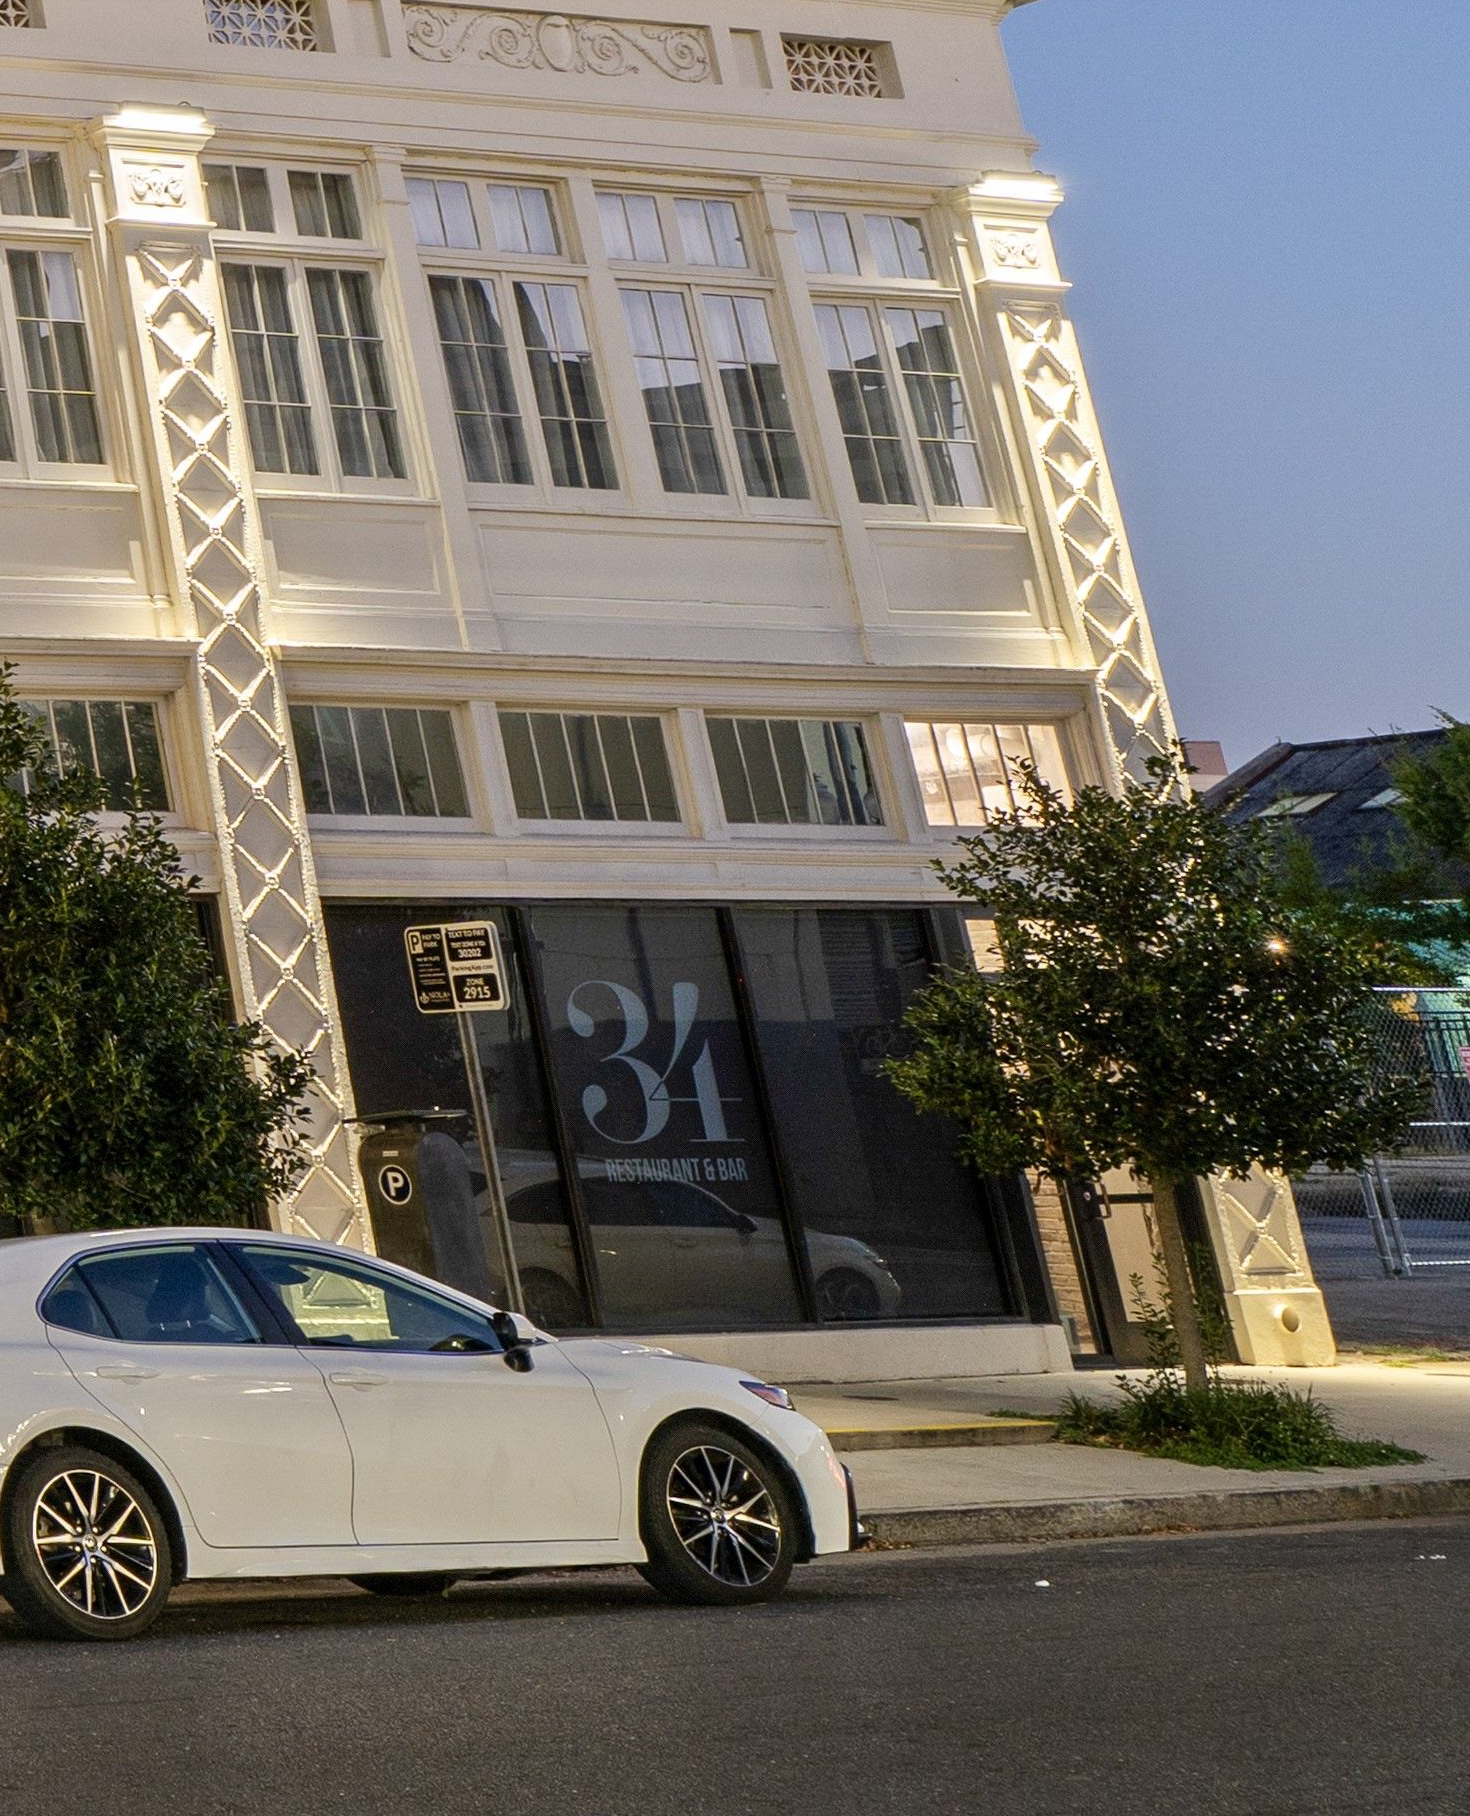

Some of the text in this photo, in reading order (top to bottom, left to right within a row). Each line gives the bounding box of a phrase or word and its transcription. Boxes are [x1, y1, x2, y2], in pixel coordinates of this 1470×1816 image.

[466, 978, 485, 986] ZONE
[463, 986, 491, 999] 2915
[567, 980, 745, 1144] 34
[604, 1158, 749, 1182] RESTAURANT & BAR
